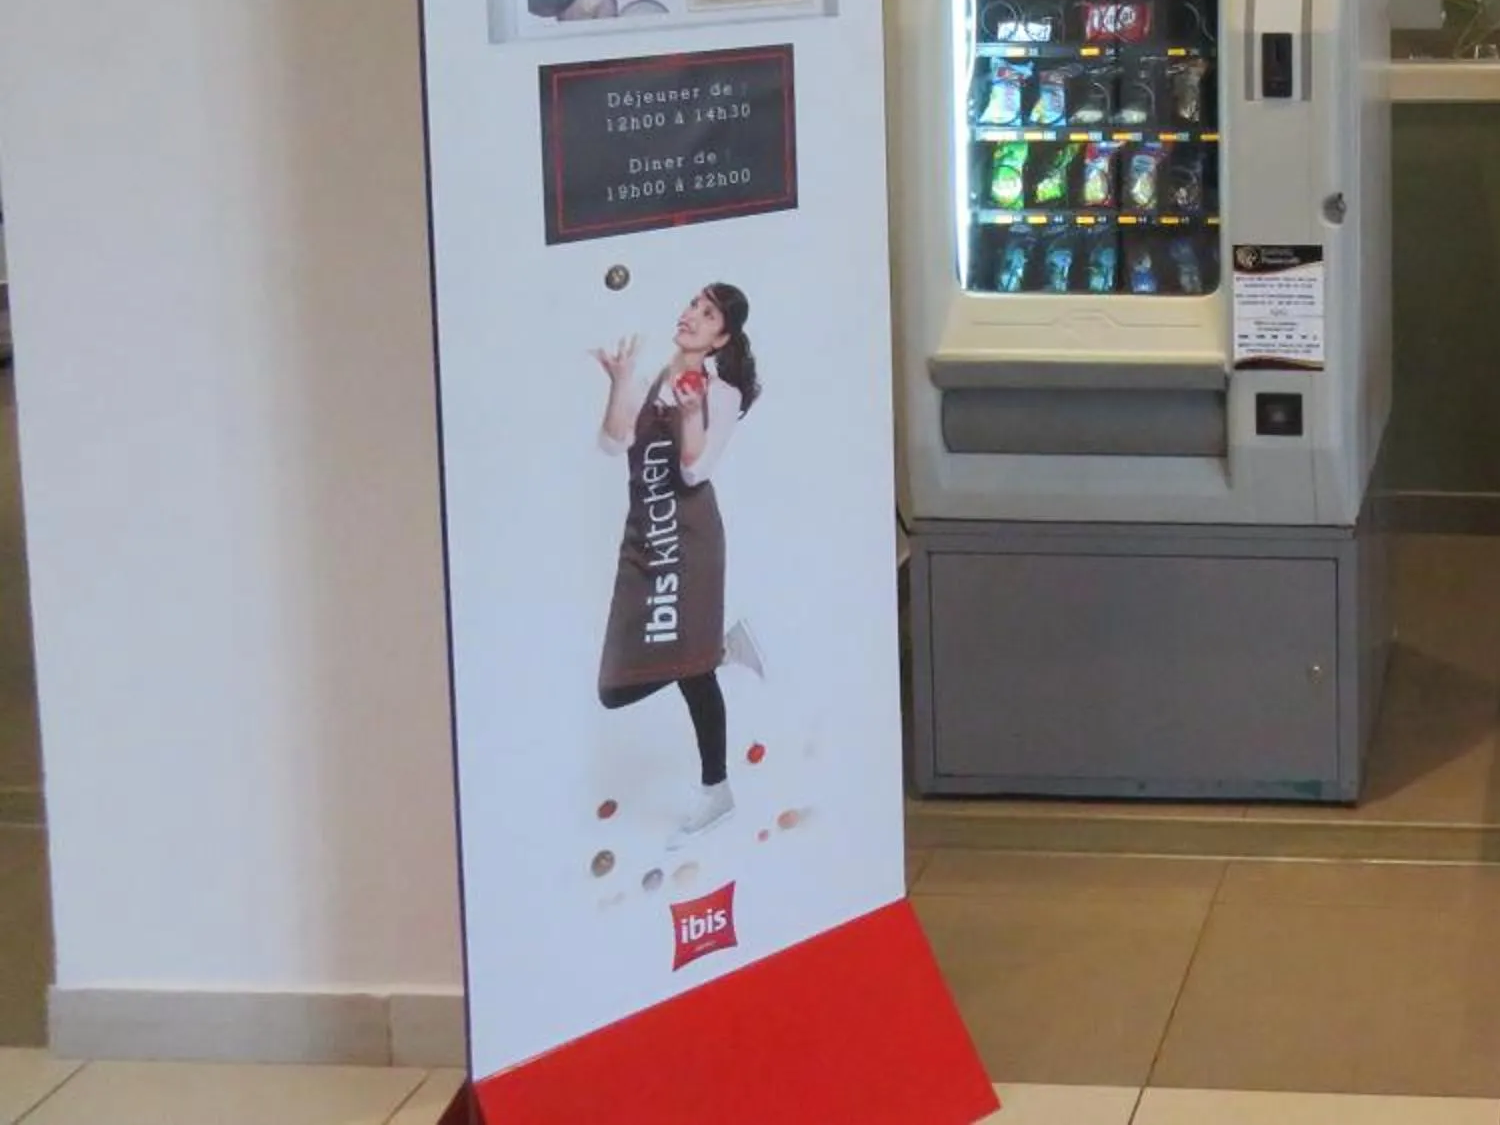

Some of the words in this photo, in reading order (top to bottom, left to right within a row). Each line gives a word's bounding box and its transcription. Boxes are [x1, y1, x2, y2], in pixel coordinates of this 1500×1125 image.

[607, 87, 701, 109] Déjeuner
[709, 81, 733, 96] de
[606, 113, 666, 132] 12h00
[695, 103, 751, 122] 14h30
[694, 150, 718, 165] de
[606, 180, 666, 202] 19h00
[694, 167, 752, 190] 22h00
[643, 439, 680, 567] kitchen
[644, 572, 679, 644] ibis
[680, 907, 728, 944] ibis
